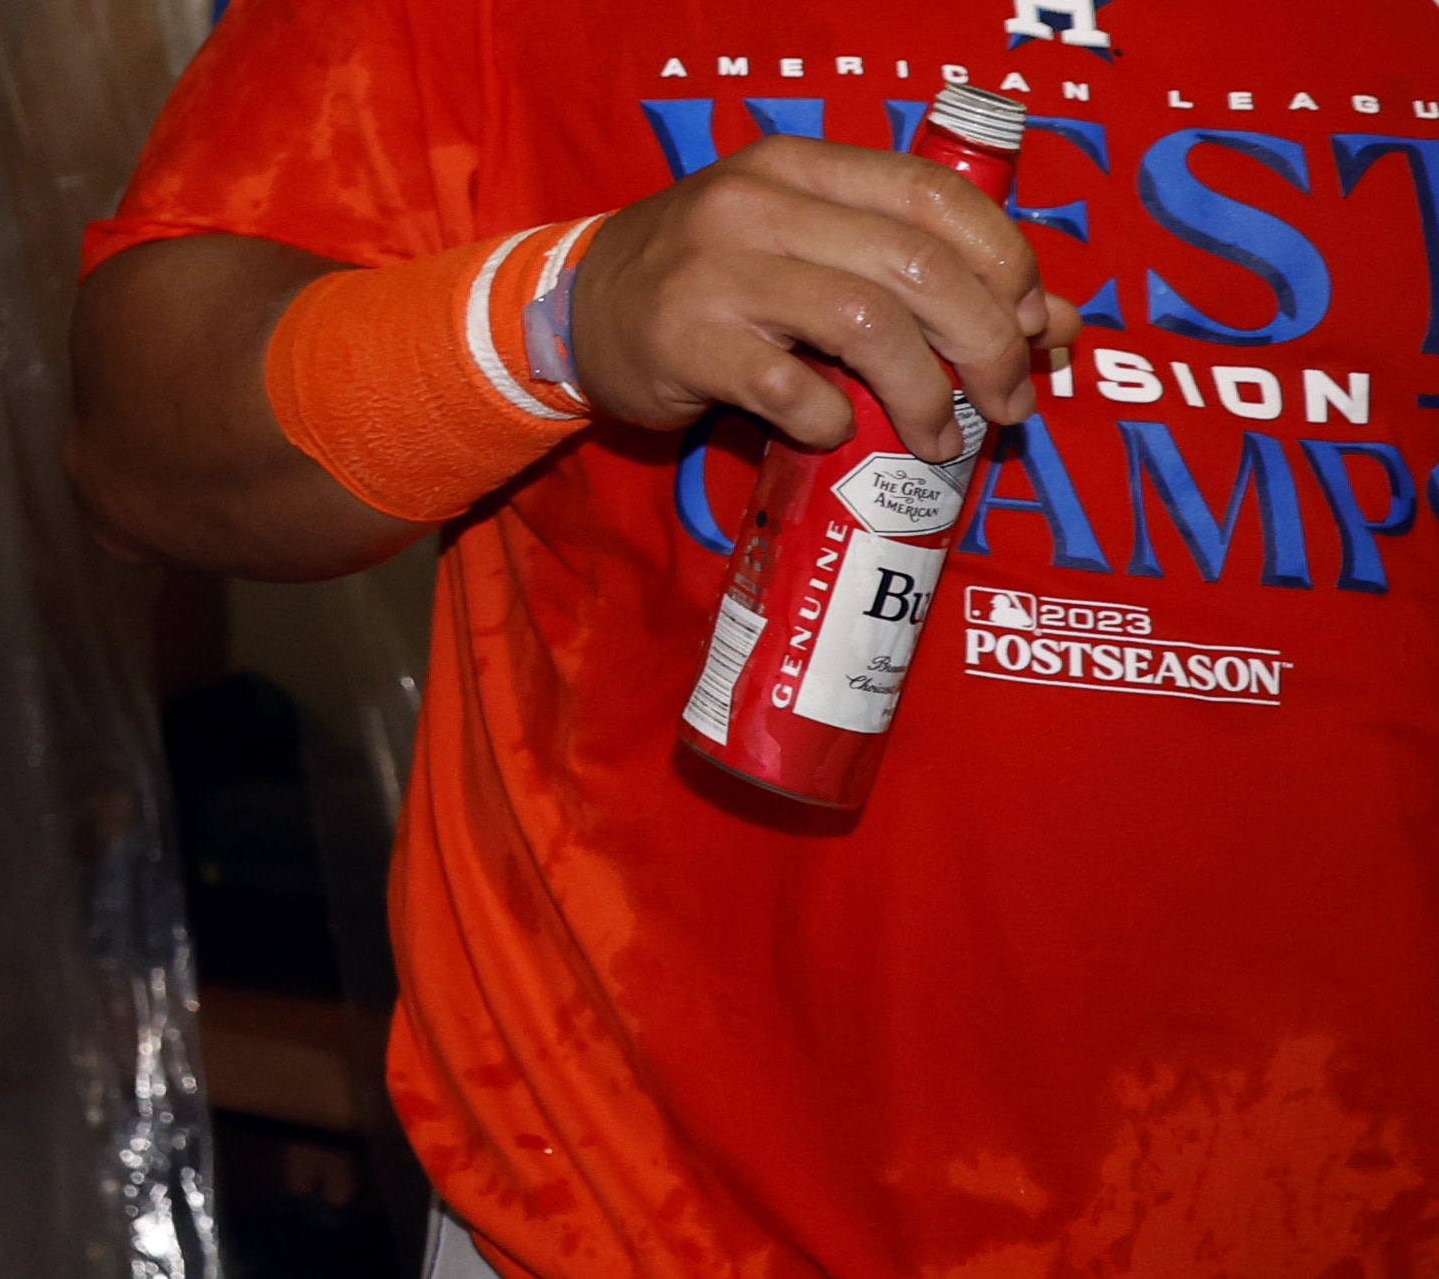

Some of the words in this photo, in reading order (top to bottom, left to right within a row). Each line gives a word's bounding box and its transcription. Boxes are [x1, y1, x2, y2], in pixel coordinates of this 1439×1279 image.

[659, 55, 1091, 102] AMERICAN
[1049, 346, 1371, 425] ISION
[771, 519, 849, 710] GENUINE
[1039, 604, 1154, 636] 2023
[964, 627, 1281, 695] POSTSEASON
